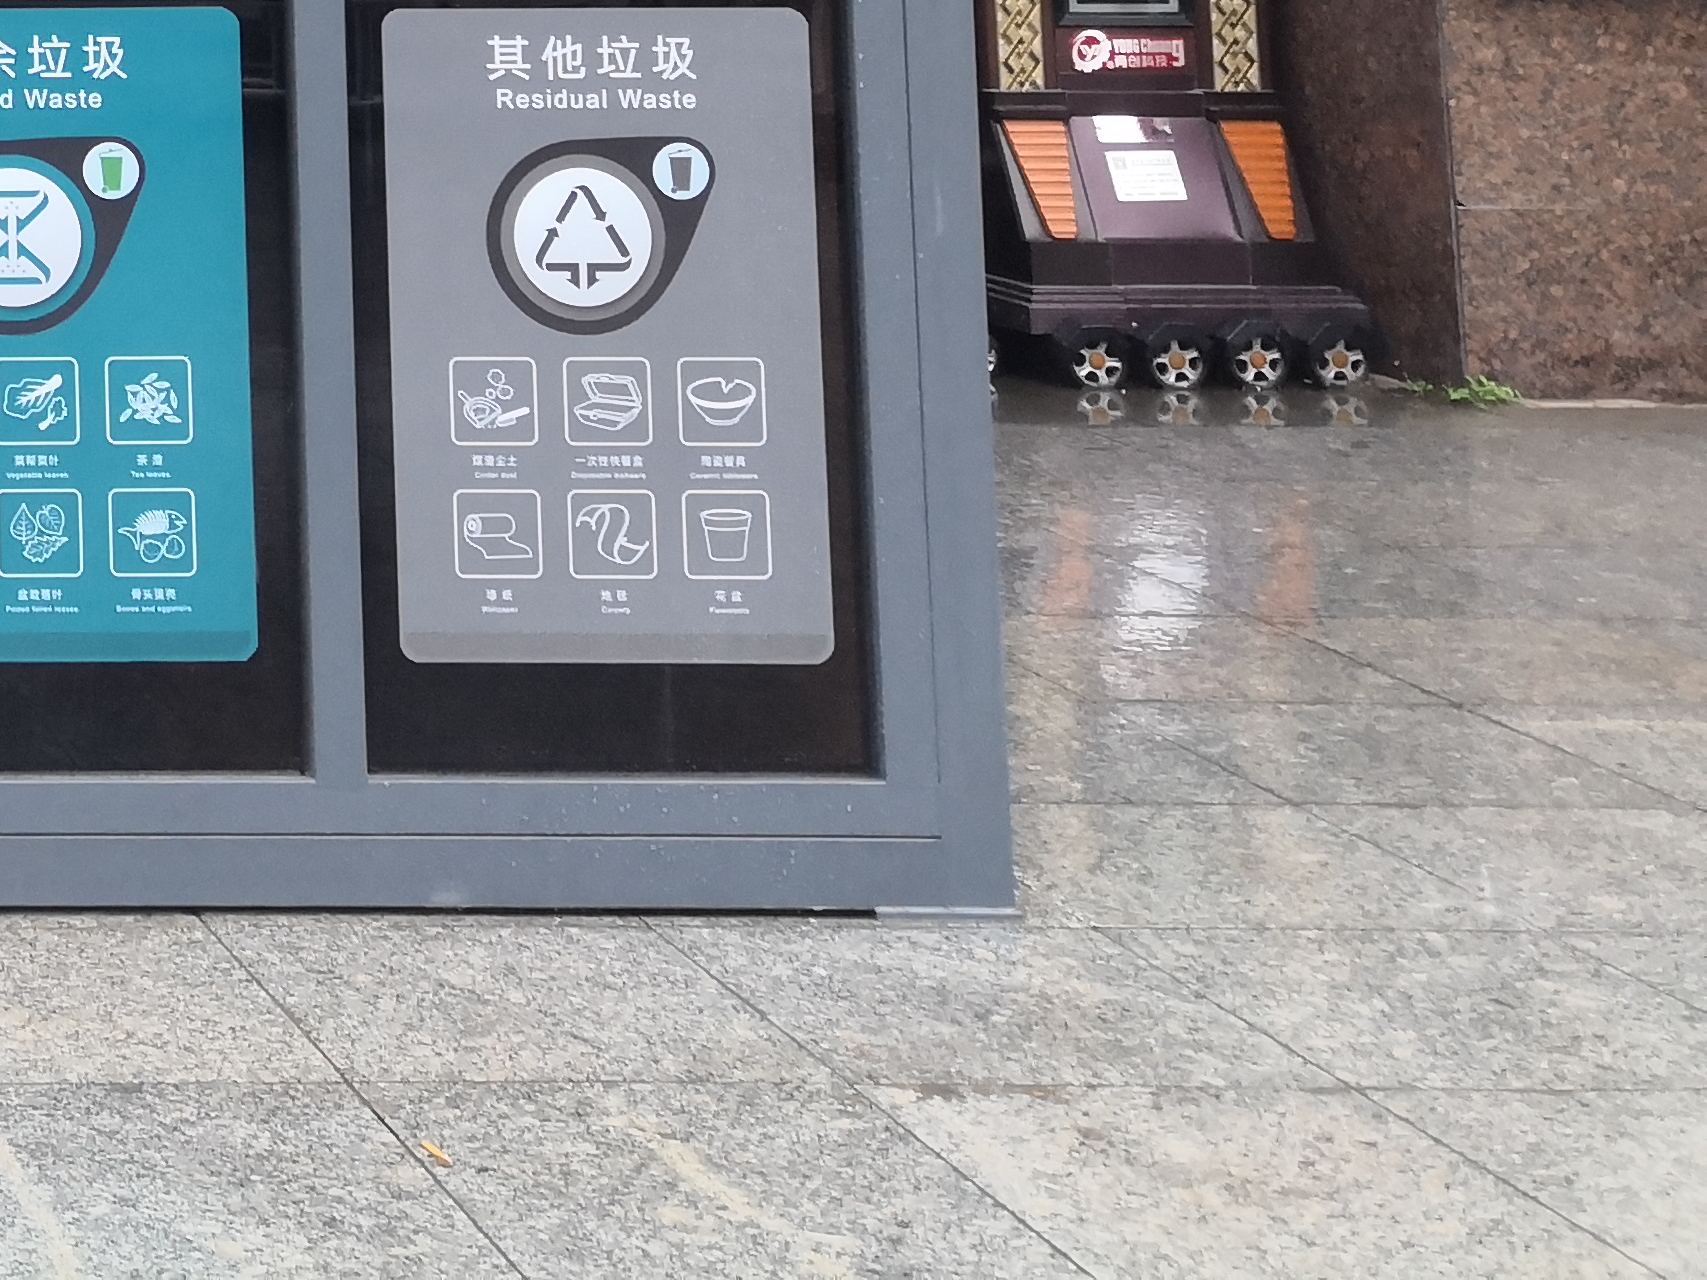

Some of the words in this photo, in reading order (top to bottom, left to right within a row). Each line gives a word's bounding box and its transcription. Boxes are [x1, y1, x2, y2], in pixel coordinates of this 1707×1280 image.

[485, 34, 697, 81] 其他垃圾
[23, 88, 102, 109] Waste
[496, 88, 608, 109] Residual
[617, 88, 697, 109] Waste
